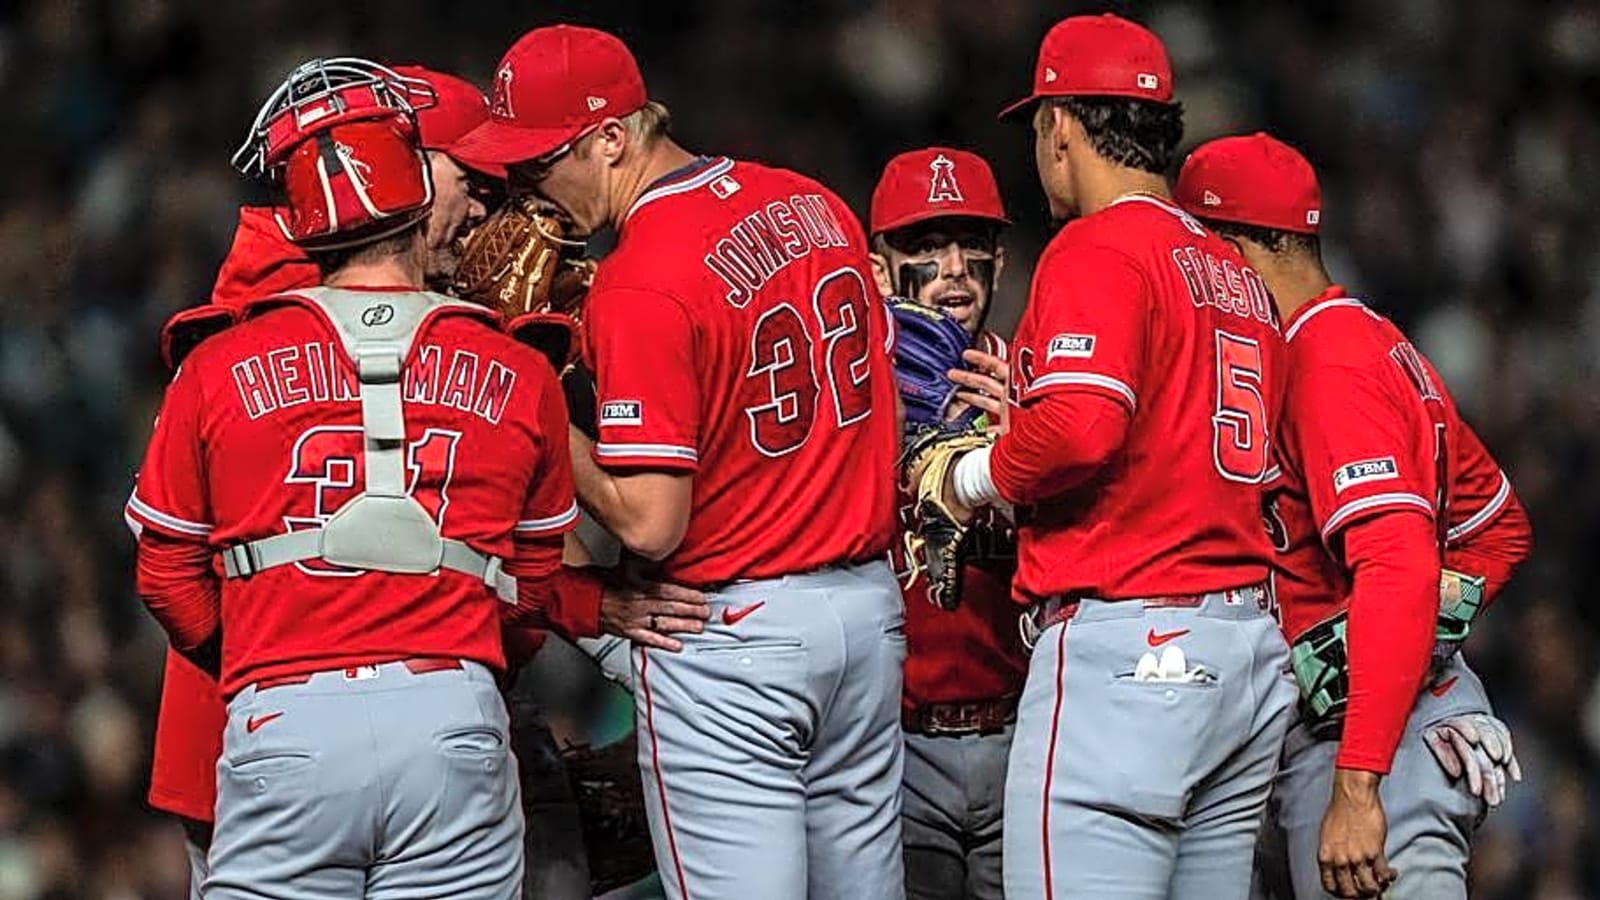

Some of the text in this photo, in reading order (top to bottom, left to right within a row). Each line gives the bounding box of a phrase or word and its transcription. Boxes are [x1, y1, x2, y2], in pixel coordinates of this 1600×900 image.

[928, 154, 964, 202] A
[705, 194, 849, 309] JOHNSON
[231, 342, 517, 425] HEINMAN
[746, 266, 873, 458] 32
[1212, 329, 1269, 484] 5
